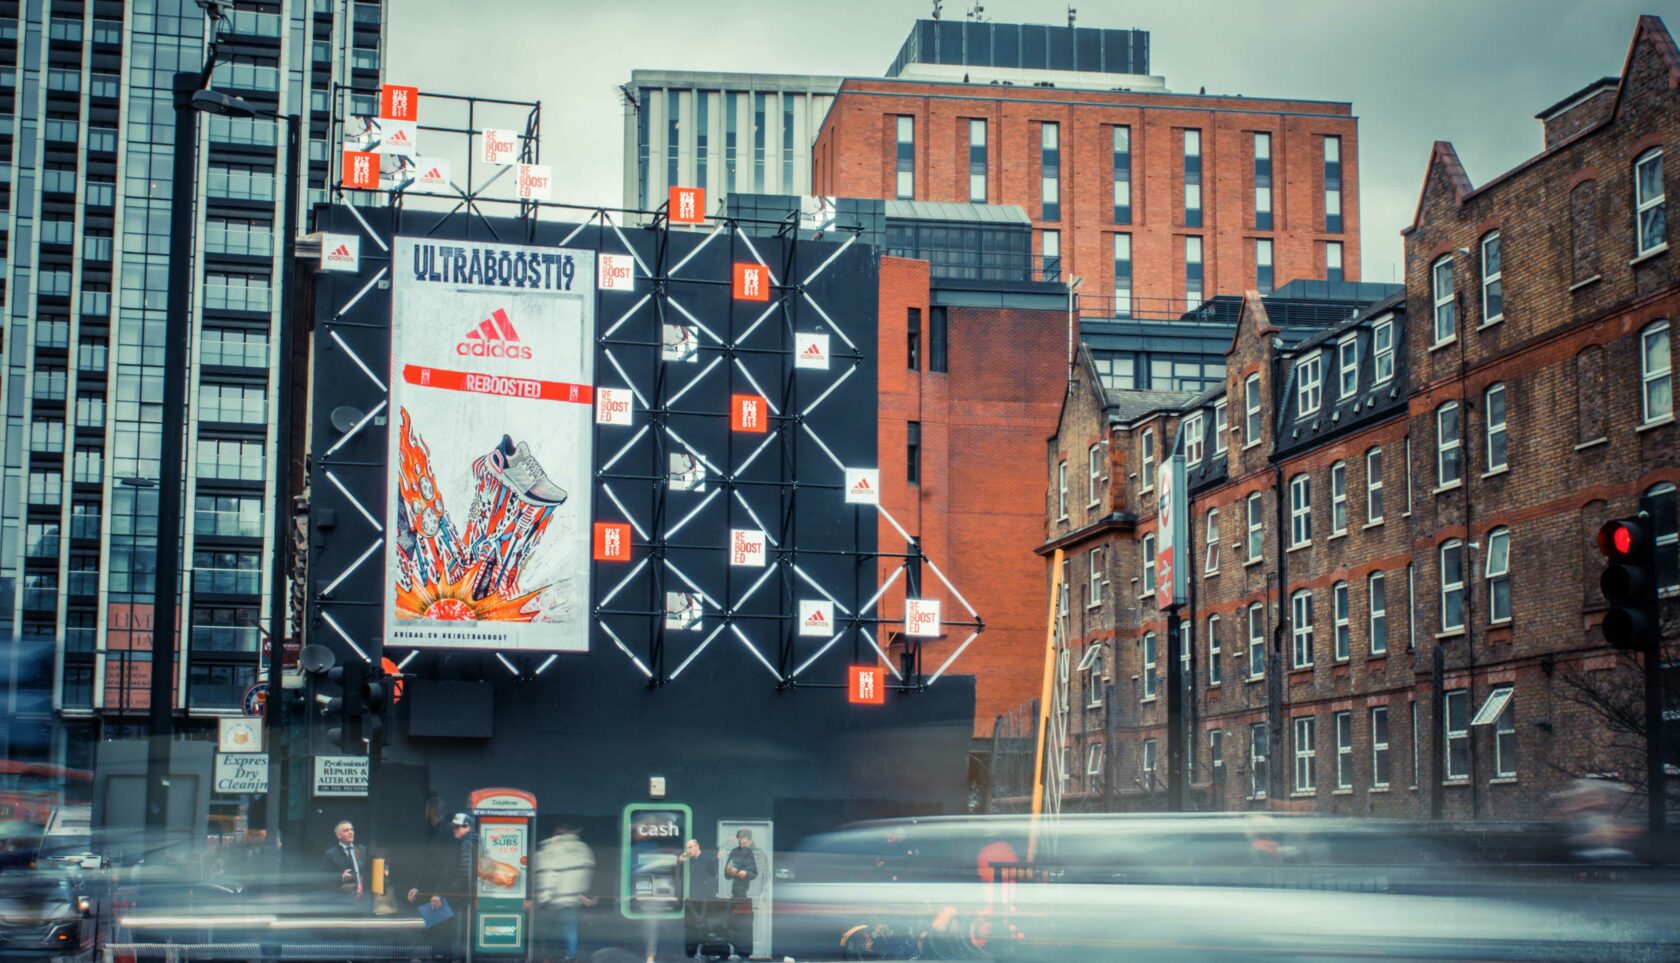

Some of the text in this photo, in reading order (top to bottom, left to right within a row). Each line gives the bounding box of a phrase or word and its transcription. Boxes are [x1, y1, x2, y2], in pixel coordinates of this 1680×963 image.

[486, 131, 496, 140] RE
[485, 141, 514, 152] BOOST
[485, 152, 496, 162] ED
[521, 166, 531, 176] RE
[521, 176, 548, 188] BOOST
[520, 188, 531, 197] ED
[603, 256, 613, 266] RE
[603, 266, 630, 278] BOOST
[603, 278, 613, 288] ED
[456, 339, 532, 360] adidas
[466, 374, 541, 398] REBOOSTED
[602, 391, 612, 401] RE
[602, 401, 629, 412] BOOST
[601, 412, 612, 422] ED
[736, 532, 745, 542] RE
[735, 542, 762, 553] BOOST
[735, 553, 745, 563] ED
[910, 602, 920, 612] RE
[910, 612, 936, 623] BOOST
[910, 623, 919, 633] ED
[224, 755, 268, 768] Expres
[324, 760, 368, 768] Professional
[235, 768, 259, 781] Dry
[219, 779, 268, 789] Cleanin
[638, 822, 679, 836] cash
